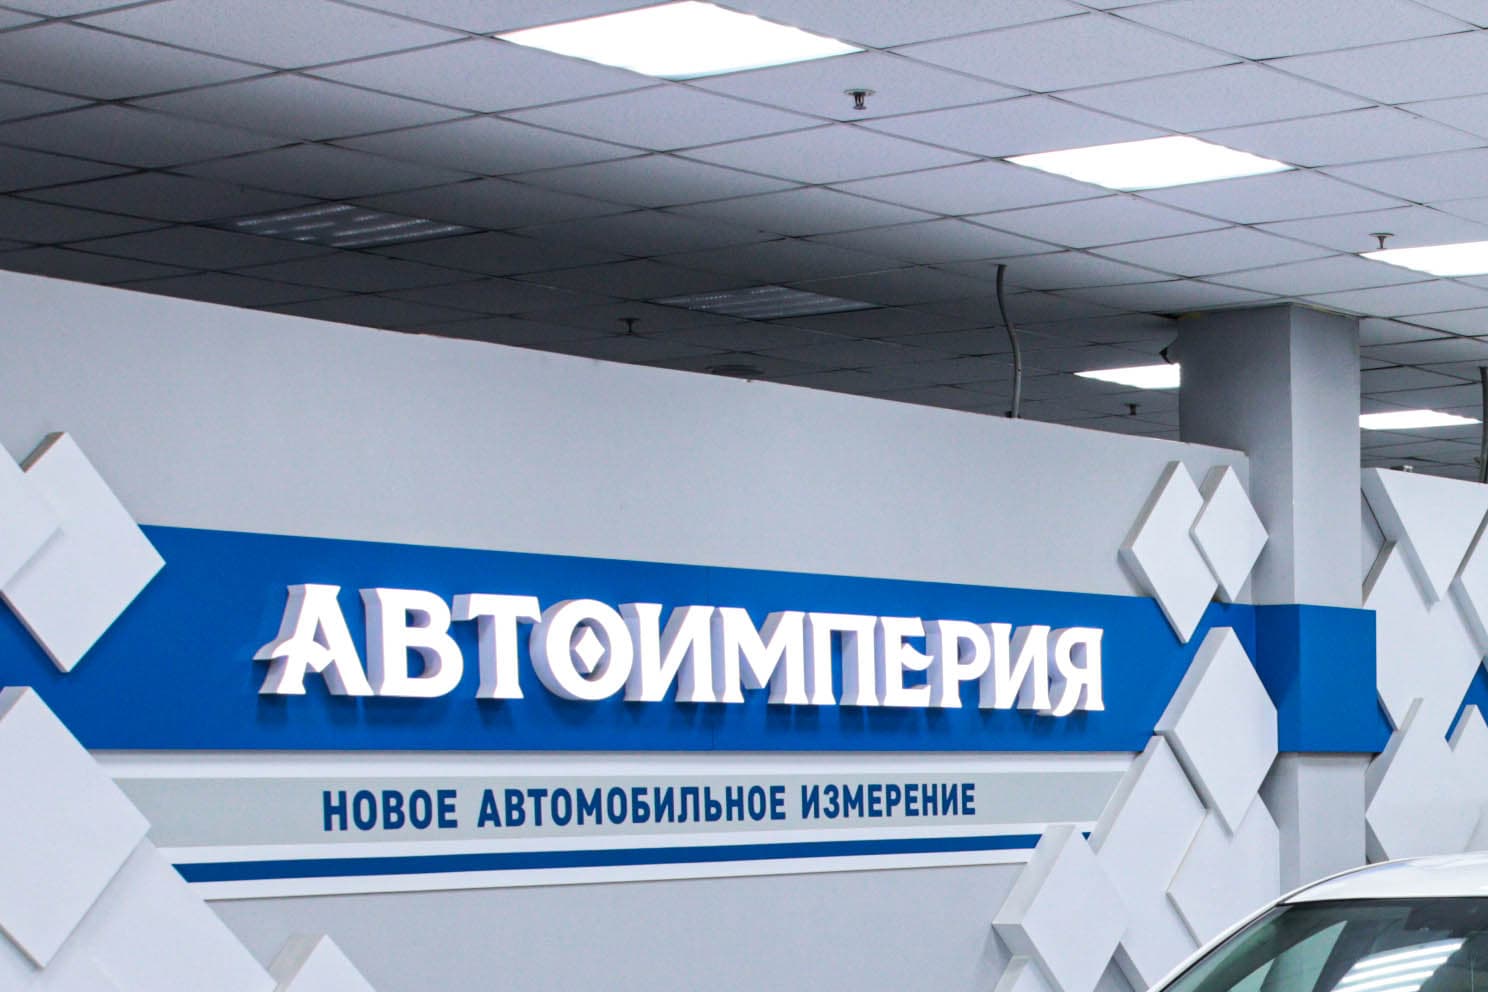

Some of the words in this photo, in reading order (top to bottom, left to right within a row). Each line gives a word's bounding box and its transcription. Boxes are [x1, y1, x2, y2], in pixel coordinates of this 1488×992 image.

[253, 583, 1105, 718] АВТОИМПЕРИЯ
[322, 788, 459, 832] НОВОЕ
[477, 784, 787, 829] АВТОМОБИЛЬНОЕ
[800, 782, 977, 821] ИЗМЕРЕНИЕ
